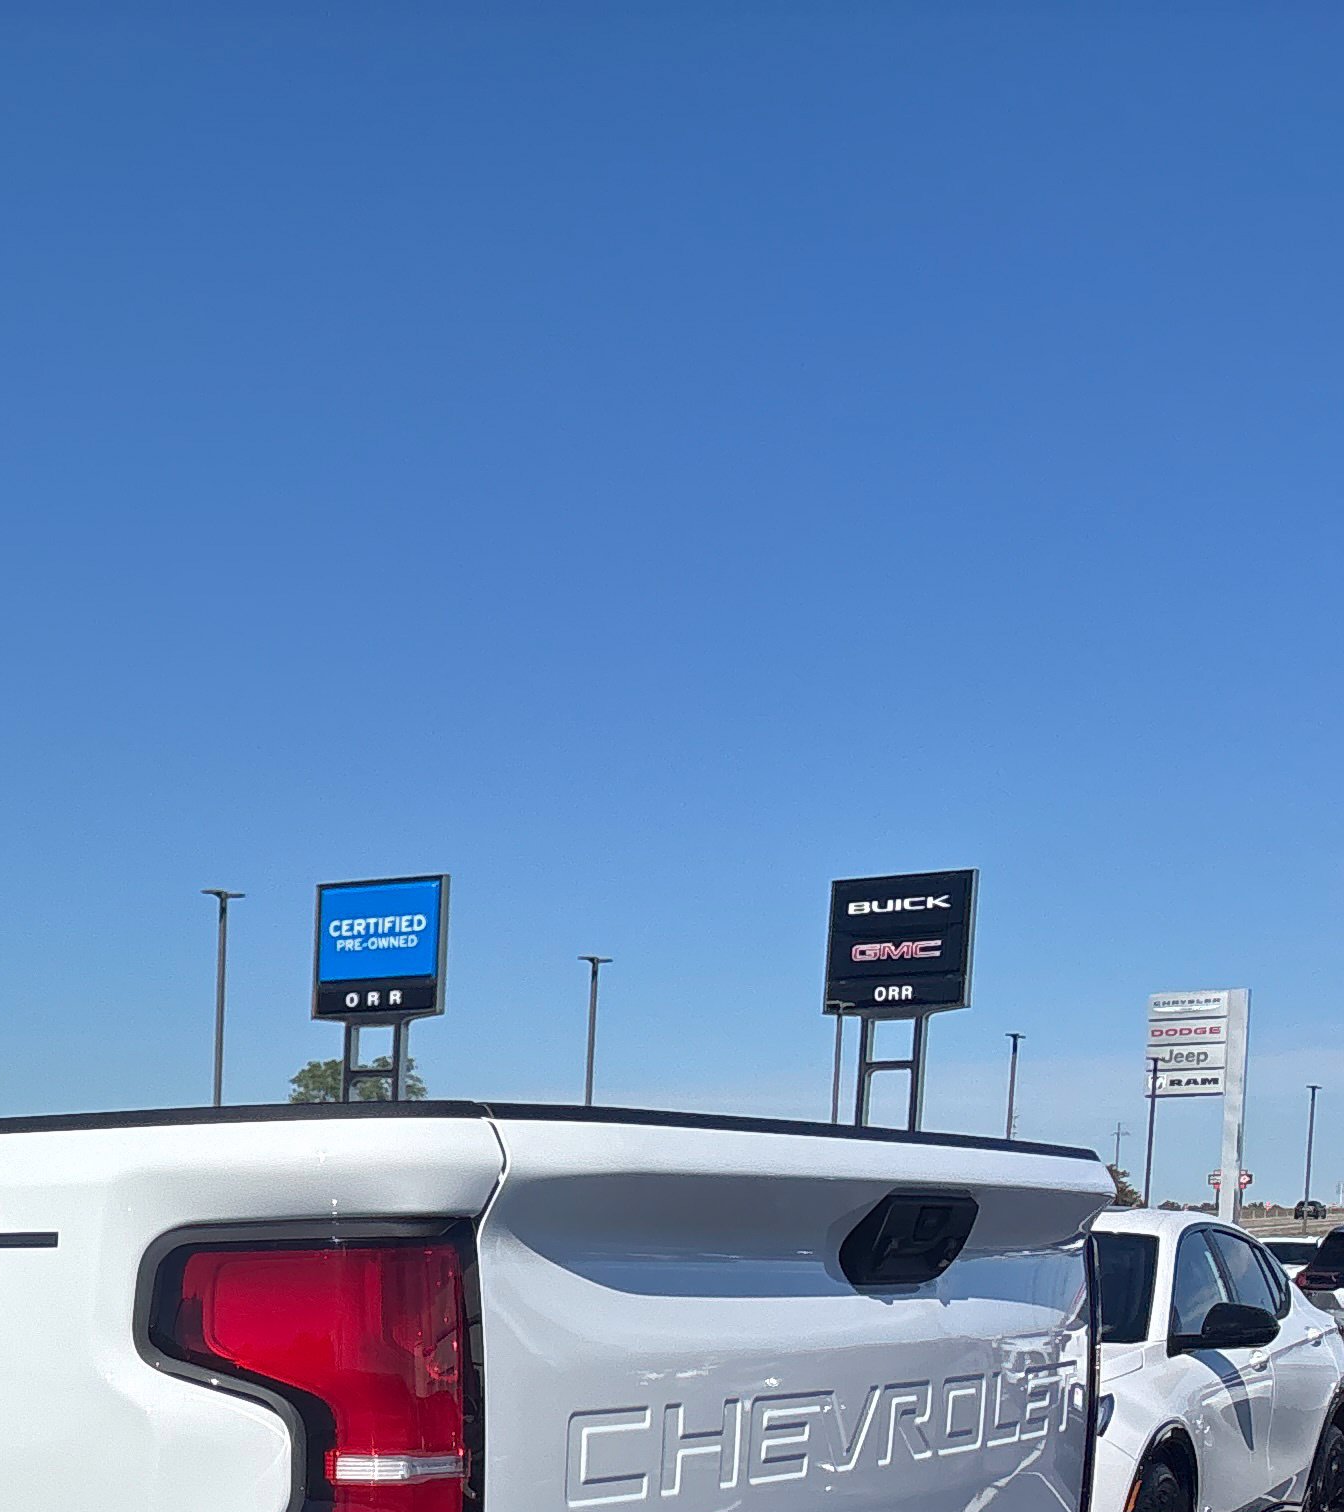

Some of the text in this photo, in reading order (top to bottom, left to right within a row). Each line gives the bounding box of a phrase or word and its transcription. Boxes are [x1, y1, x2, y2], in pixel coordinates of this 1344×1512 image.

[847, 895, 952, 916] BUICK
[328, 914, 428, 938] CERTIFIED
[335, 934, 419, 952] PRE-OWNED
[851, 939, 943, 962] GMC
[345, 989, 403, 1008] ORR
[873, 985, 913, 1002] ORR
[1150, 1026, 1222, 1038] DODGE
[1161, 1049, 1209, 1066] Jeep
[1168, 1077, 1220, 1087] RAM
[565, 1360, 1078, 1508] CHEVROLET
